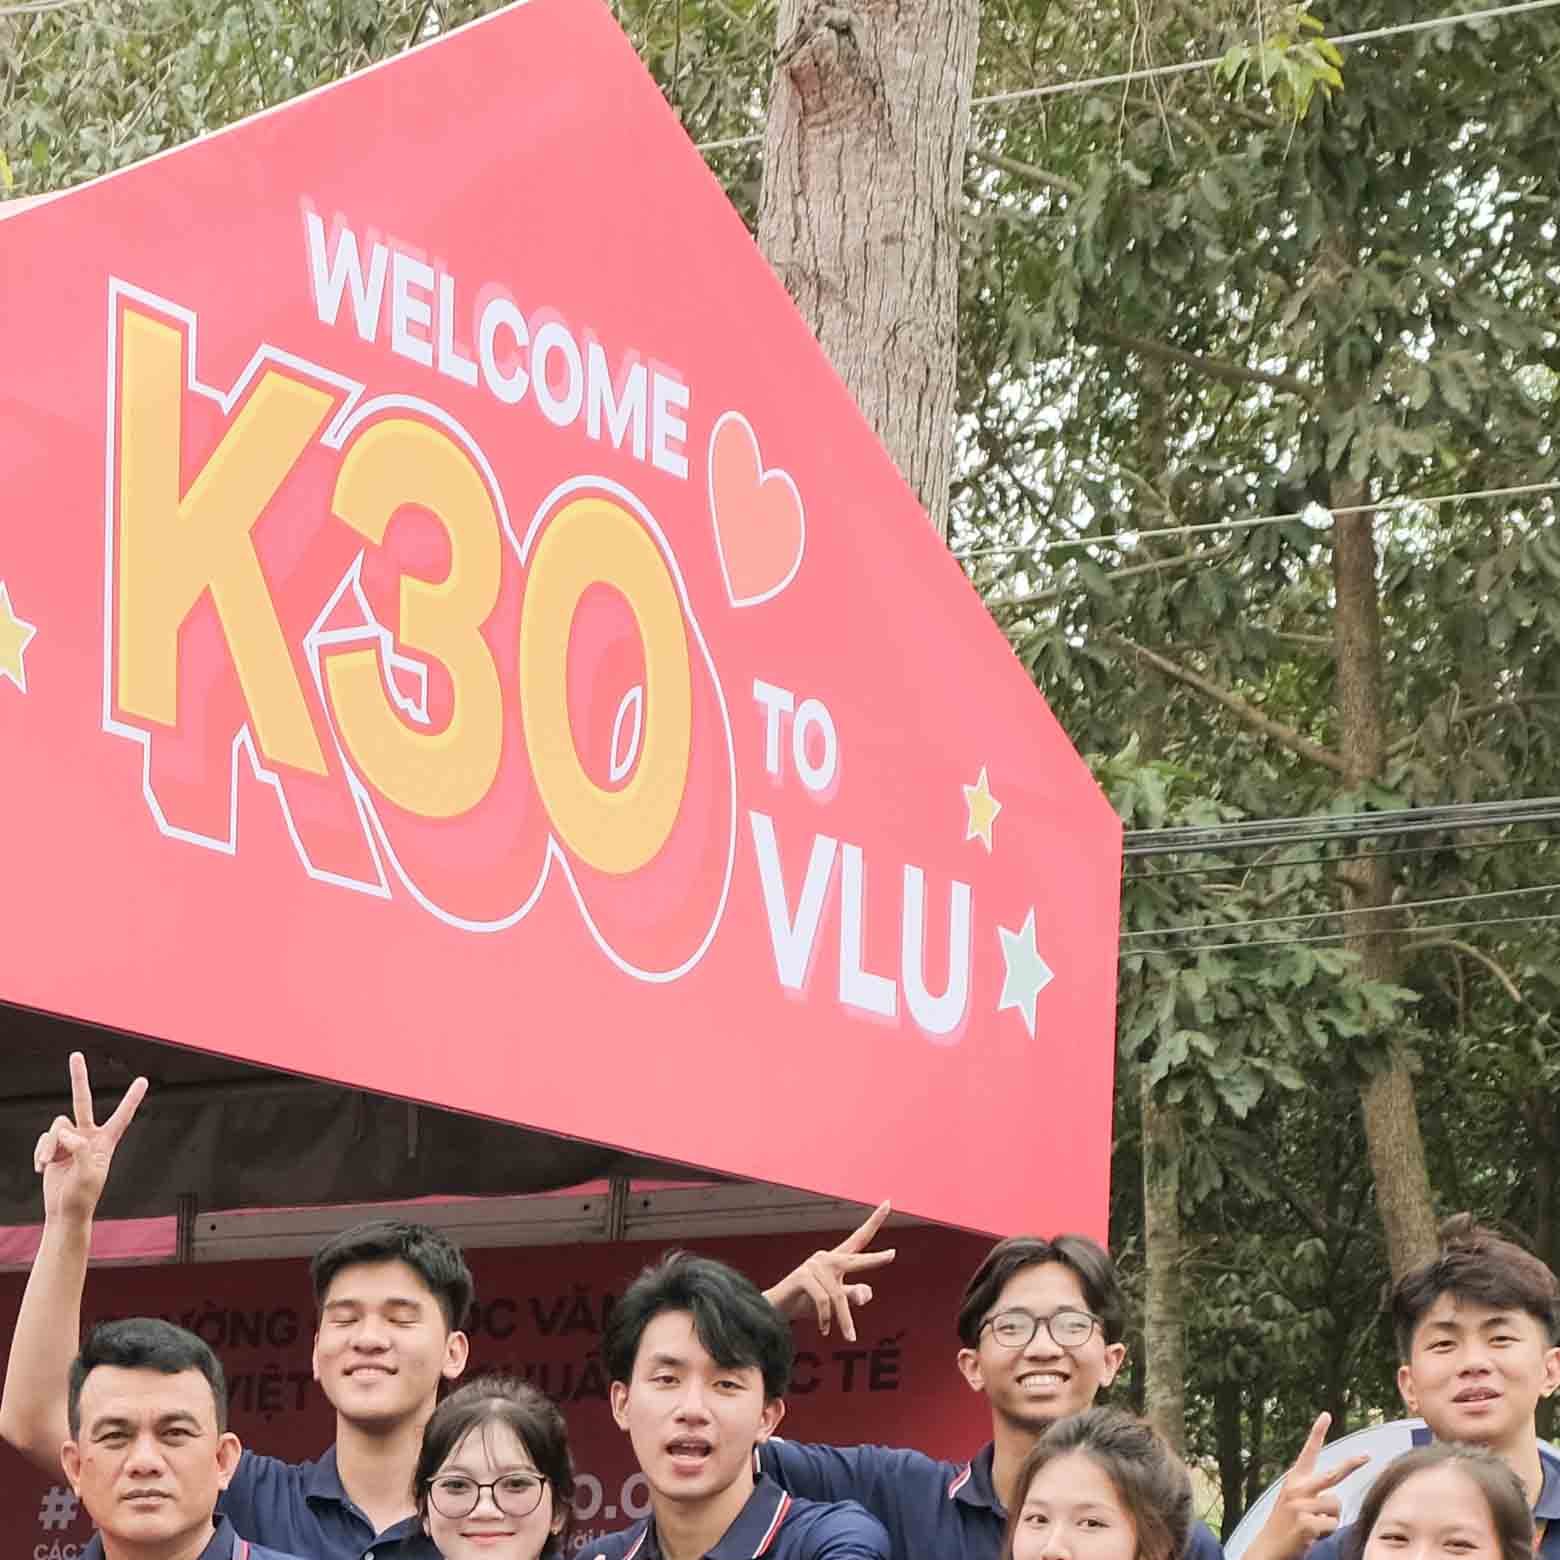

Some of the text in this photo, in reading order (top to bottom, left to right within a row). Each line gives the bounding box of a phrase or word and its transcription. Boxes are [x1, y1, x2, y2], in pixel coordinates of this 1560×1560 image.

[306, 208, 690, 481] WELCOME
[114, 300, 694, 878] K30
[753, 679, 838, 791] TO
[748, 810, 972, 1034] VLU
